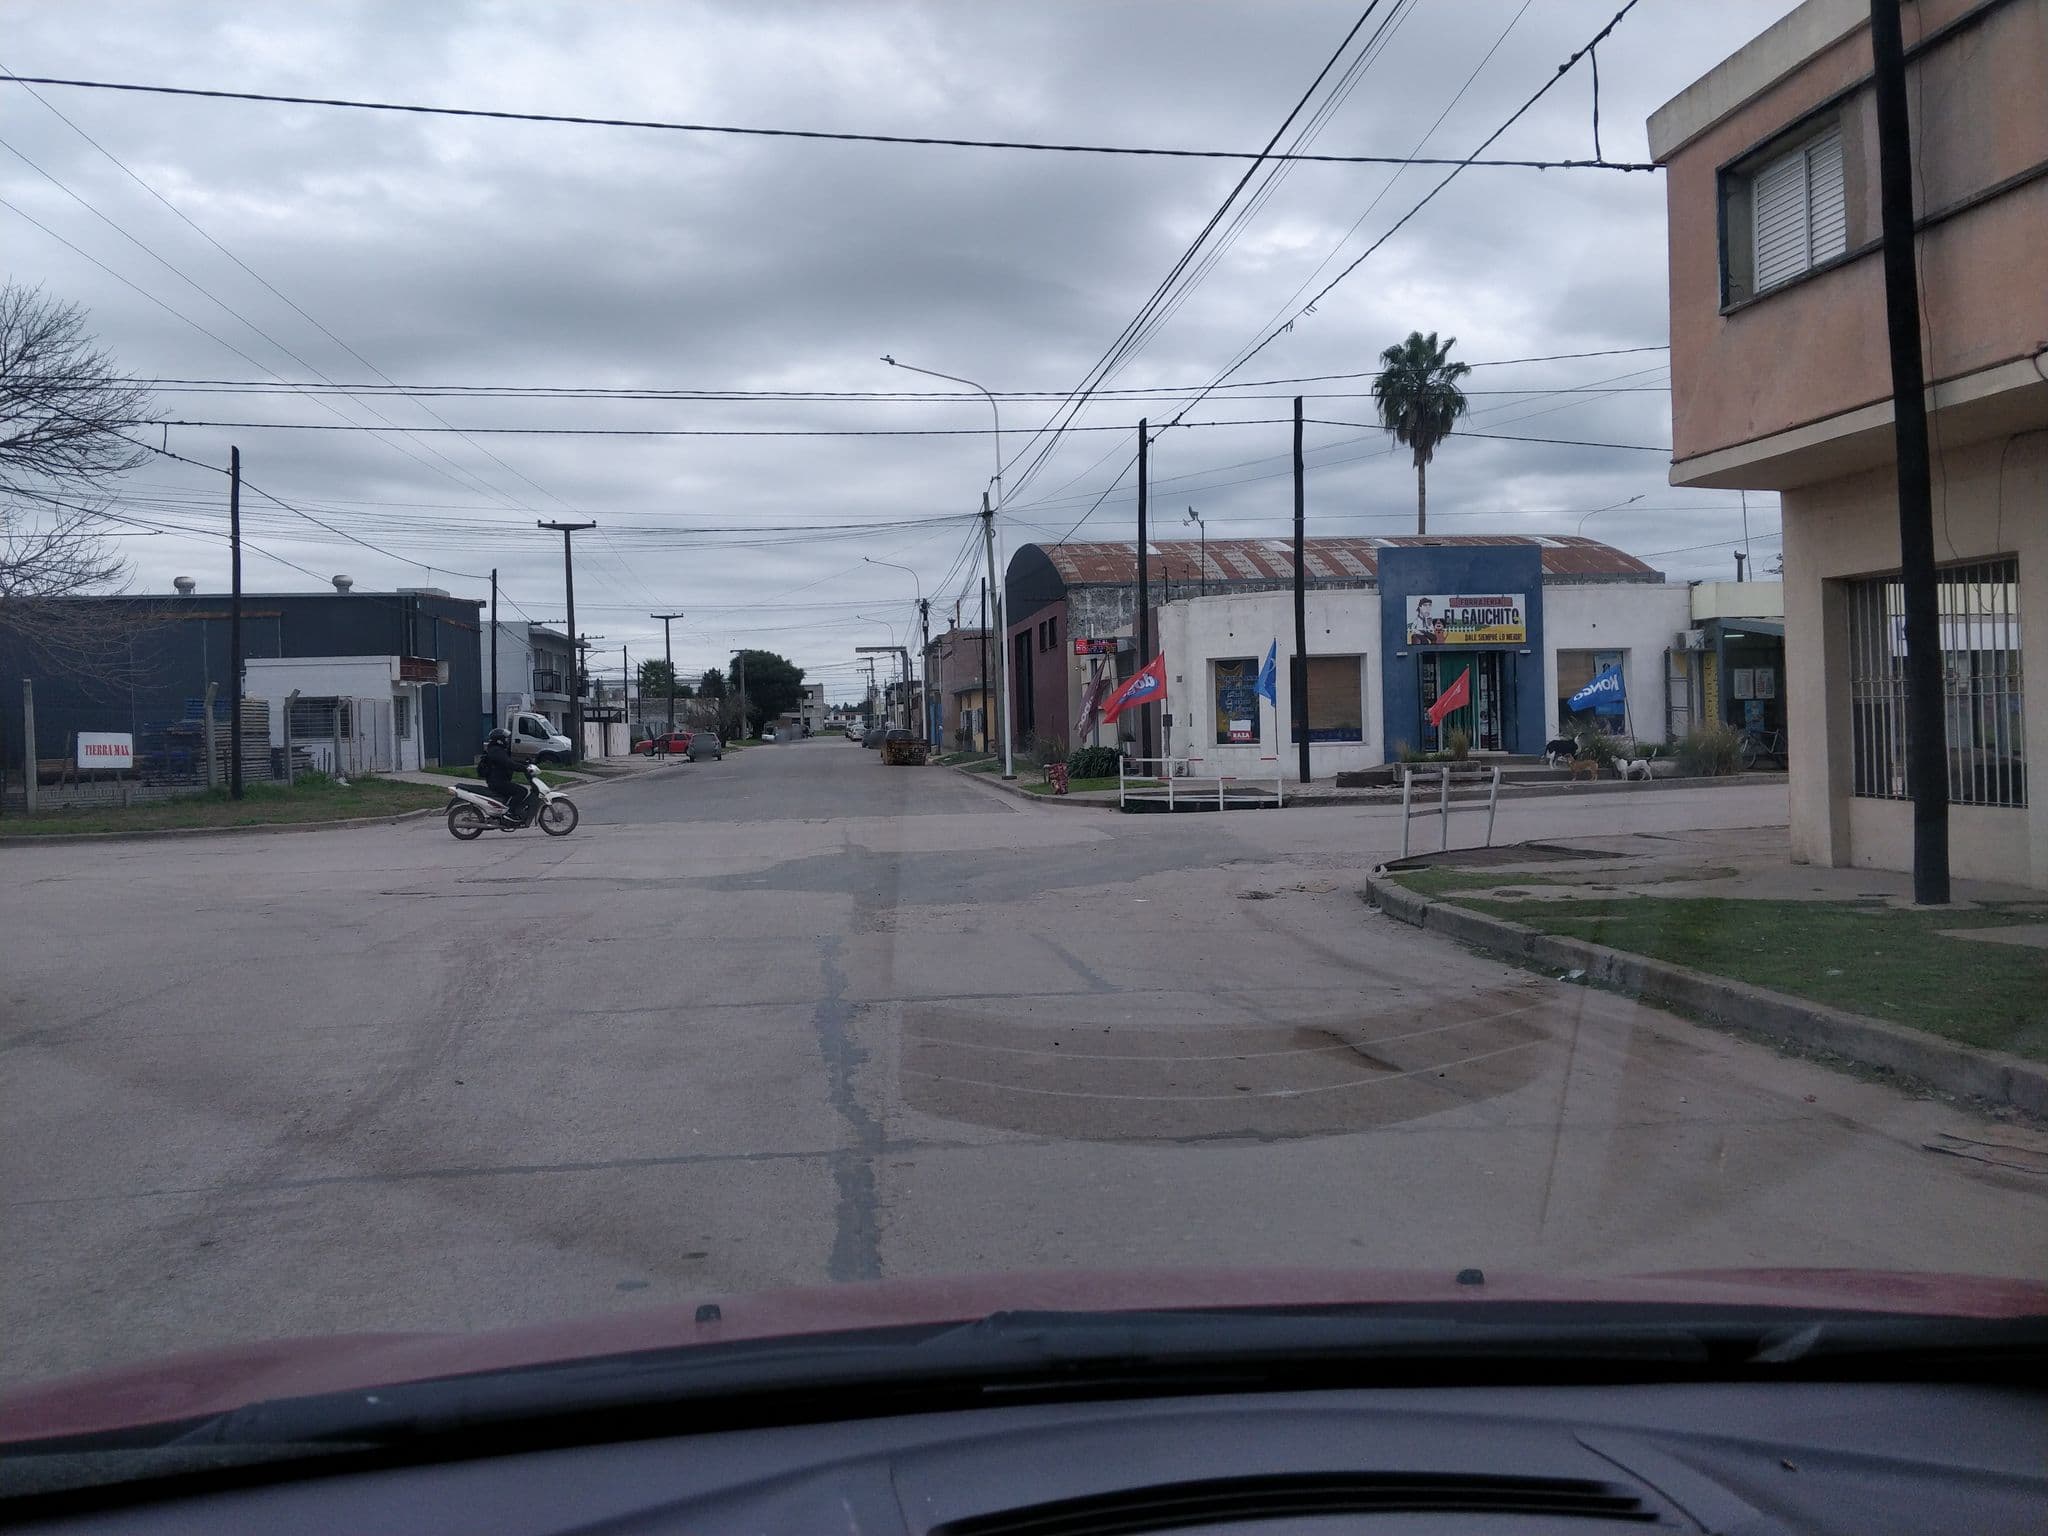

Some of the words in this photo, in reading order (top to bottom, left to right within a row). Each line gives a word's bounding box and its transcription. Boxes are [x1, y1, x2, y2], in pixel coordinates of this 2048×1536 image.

[1444, 609, 1456, 625] EL
[1462, 608, 1519, 625] GAUCHITO
[85, 744, 113, 756] TIERRA
[114, 744, 130, 756] MAX
